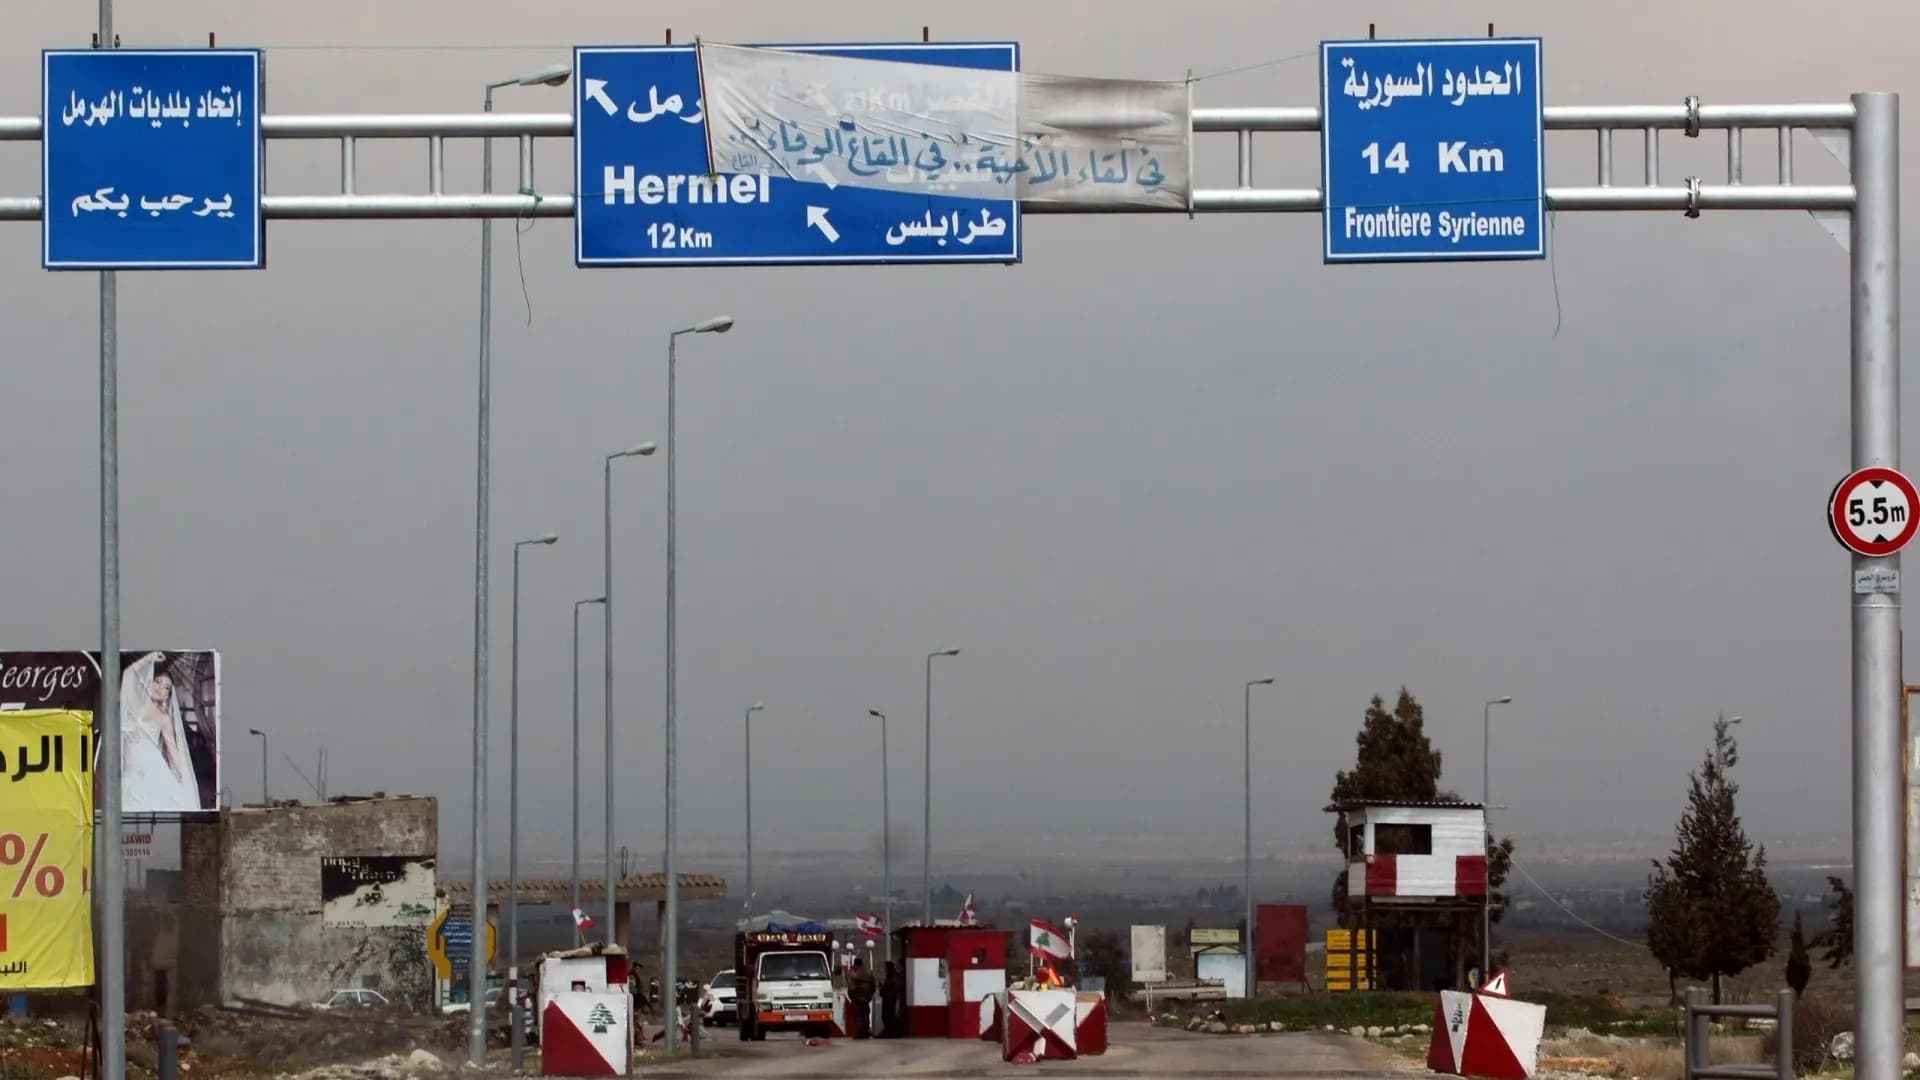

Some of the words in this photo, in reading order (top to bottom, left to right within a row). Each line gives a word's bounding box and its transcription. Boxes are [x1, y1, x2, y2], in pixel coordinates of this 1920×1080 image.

[1341, 57, 1434, 110] السورية
[1442, 60, 1522, 106] الحدود
[62, 89, 123, 127] الهرمل
[129, 86, 191, 128] بلديات
[197, 85, 242, 127] إتحاد
[848, 134, 909, 176] القاع
[915, 131, 947, 181] في
[1077, 147, 1129, 184] لقاء
[1136, 145, 1165, 194] في
[1361, 141, 1410, 174] 14
[1438, 141, 1505, 173] Km
[71, 187, 130, 218] بكم
[140, 193, 235, 218] يرحب
[603, 165, 770, 205] Hermel
[885, 207, 1007, 246] طرابلس
[1345, 205, 1432, 239] Frontiere
[1438, 210, 1525, 243] Syrienne
[0, 659, 87, 702] eorges
